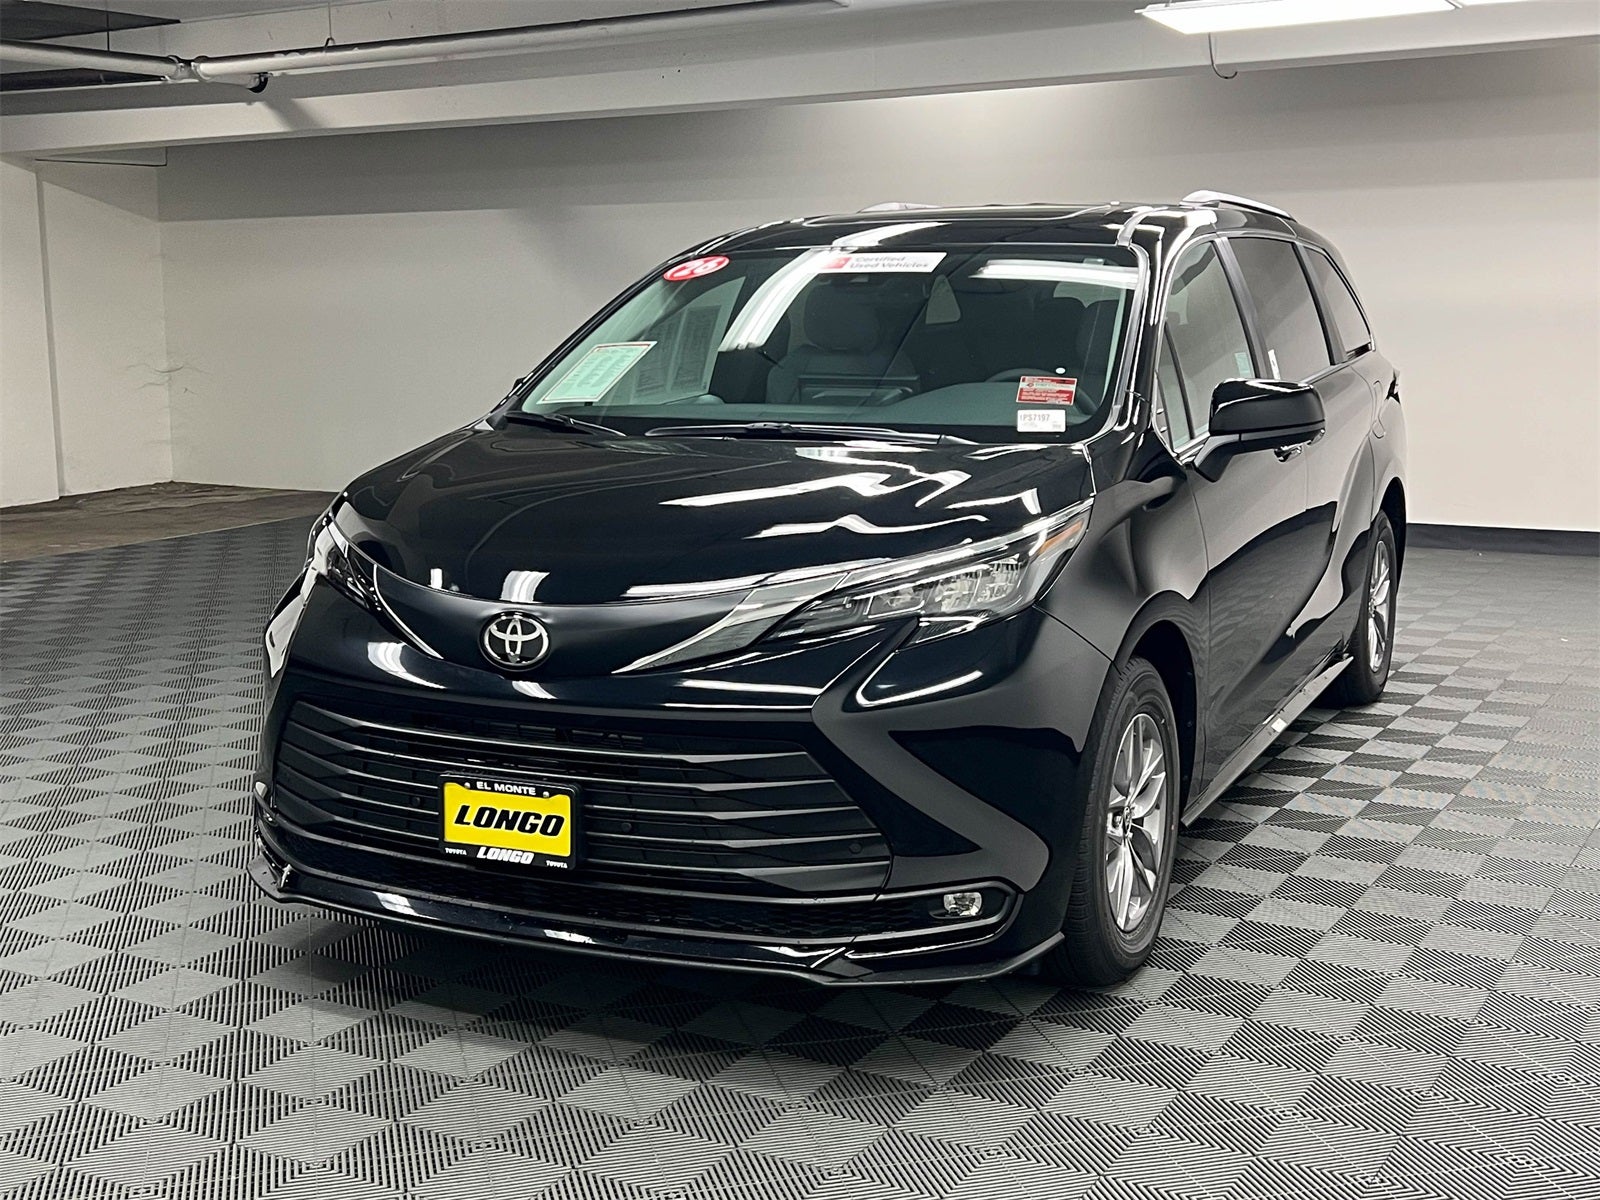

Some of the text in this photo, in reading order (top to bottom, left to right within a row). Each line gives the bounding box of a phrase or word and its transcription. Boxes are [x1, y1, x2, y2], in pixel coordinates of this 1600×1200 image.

[476, 781, 536, 796] EL MONTE
[454, 804, 565, 836] LONGO
[476, 846, 534, 865] LONGO
